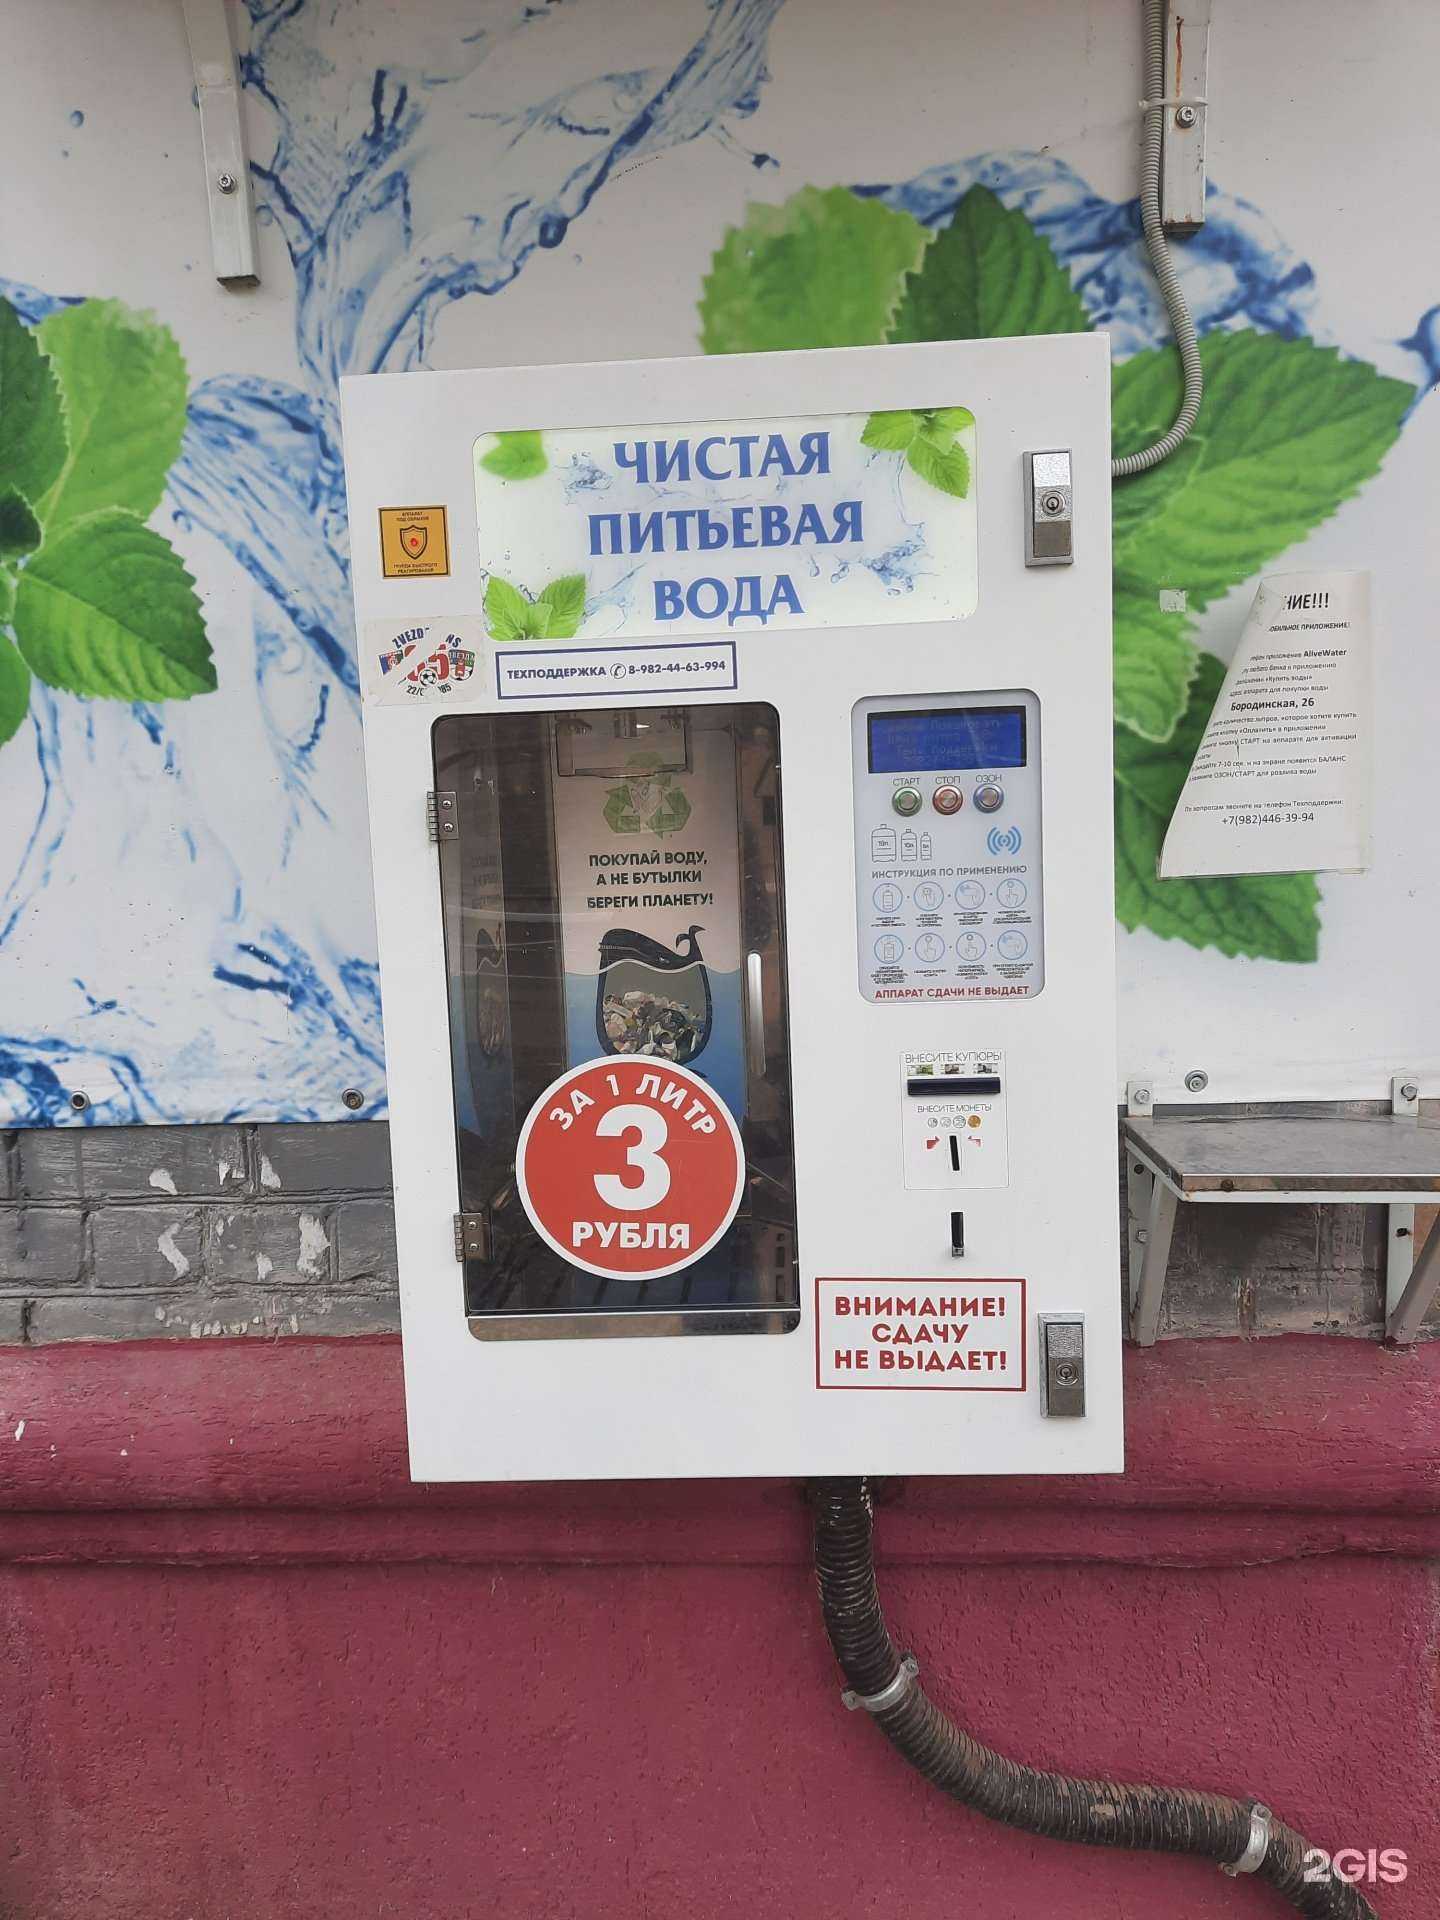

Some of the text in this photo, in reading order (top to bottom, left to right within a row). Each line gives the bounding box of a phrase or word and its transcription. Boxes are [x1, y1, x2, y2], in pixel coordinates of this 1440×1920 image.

[614, 431, 831, 484] ЧИСТАЯ
[588, 501, 864, 555] ПИТЬЕВАЯ
[654, 574, 805, 626] ВОДА
[1304, 649, 1347, 657] AliveWater
[506, 660, 726, 681] ТЕХПОДДЕРЖКА 8-982-44-63-994
[1231, 698, 1315, 711] Бородинская, 26
[893, 777, 920, 786] СТАРТ
[935, 776, 961, 785] СТОП
[976, 774, 1003, 783] ОЗОН
[1222, 812, 1314, 826] +7(982)446-39-94
[589, 850, 707, 867] ПОКУПАЙ ВОДУ,
[596, 870, 702, 886] А НЕ БУТЫЛКИ
[872, 865, 1027, 879] ИНСТРУКЦИЯ ПО ПРИМЕНЕНИЮ
[588, 893, 713, 909] БЕРЕГИ ПЛАНЕТУ!
[875, 985, 1030, 999] АППАРАТ СДАЧИ НЕ ВЫДАЕТ
[905, 1051, 1002, 1064] ВНЕСИТЕ КУПЮРЫ
[550, 1073, 717, 1135] ЗА 1 ЛИТР
[917, 1103, 992, 1113] ВНЕСИТЕ МОНЕТЫ
[593, 1104, 671, 1210] 3
[572, 1221, 690, 1249] РУБЛЯ
[835, 1296, 1006, 1317] ВНИМАНИЕ!
[871, 1323, 969, 1345] СДАЧУ
[834, 1349, 1007, 1372] НЕ ВЫДАЕТ!
